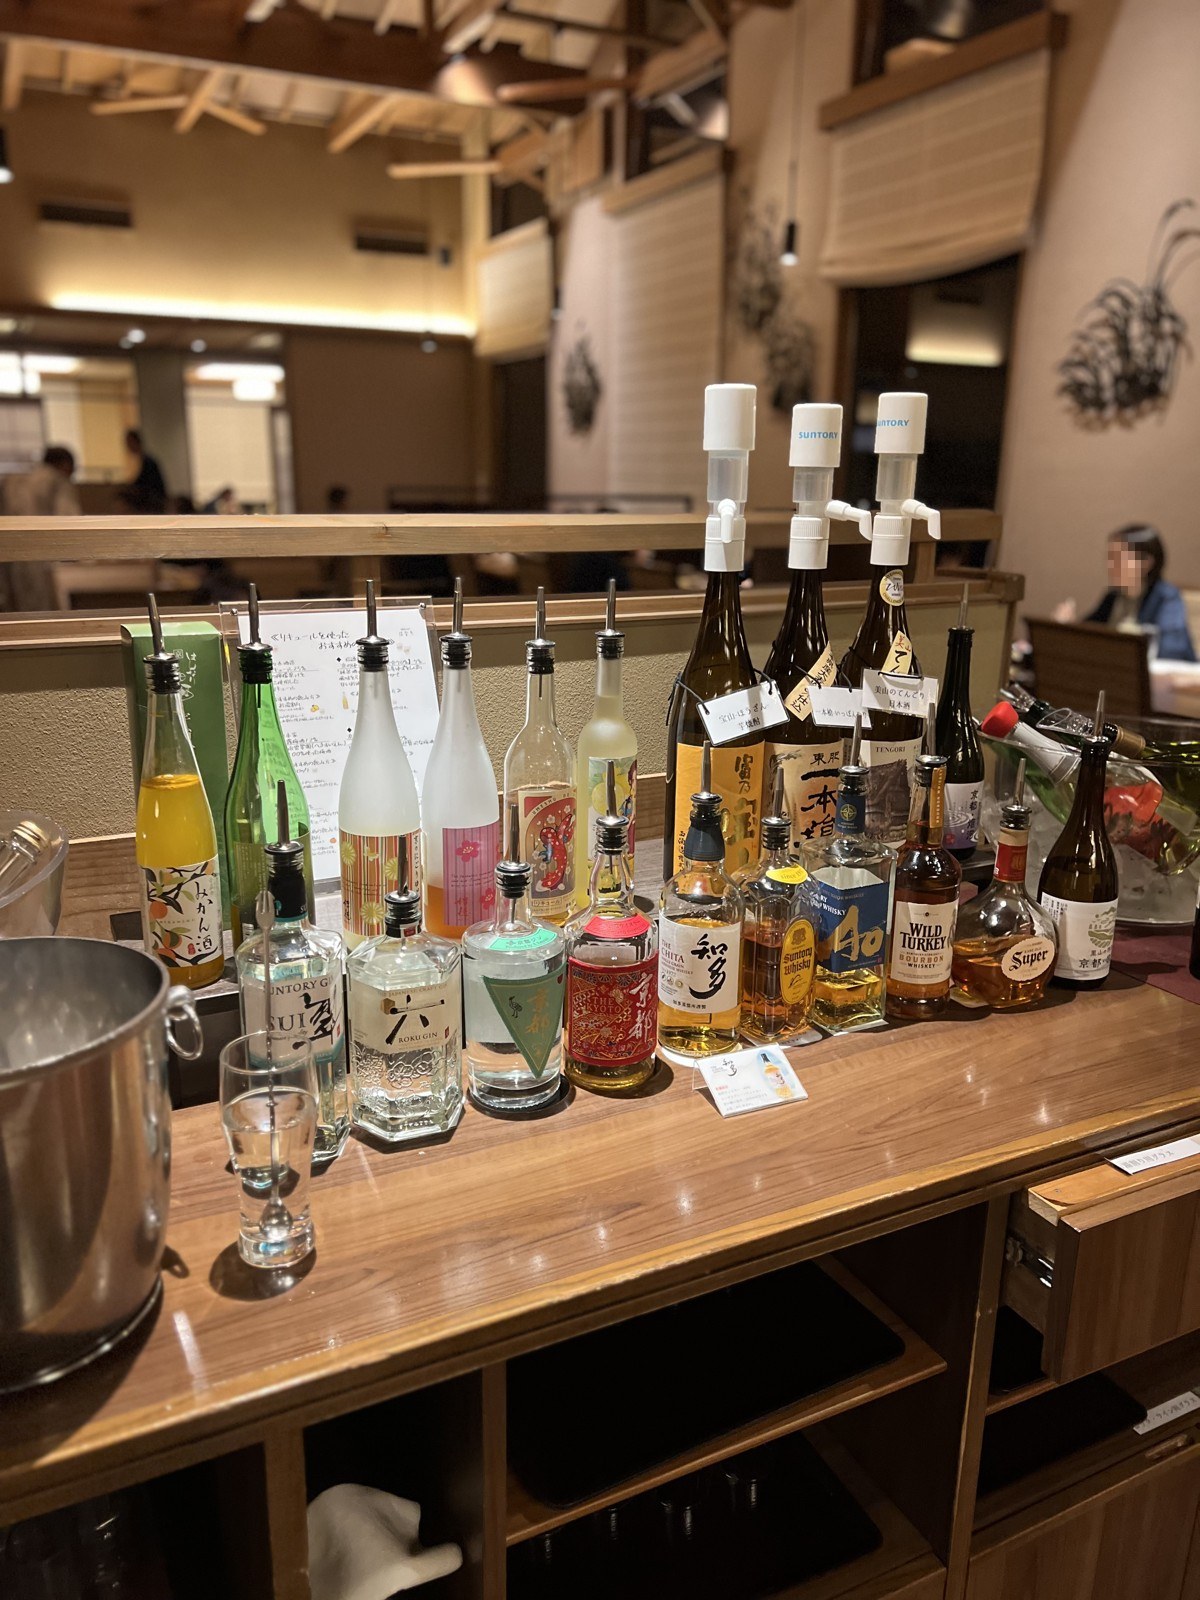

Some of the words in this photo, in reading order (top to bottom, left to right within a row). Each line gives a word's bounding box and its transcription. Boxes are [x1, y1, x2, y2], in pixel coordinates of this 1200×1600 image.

[877, 418, 910, 427] UNTORY
[798, 430, 839, 440] SUNTORY
[889, 700, 911, 710] 日本酒
[195, 881, 214, 952] みかん酒
[823, 902, 846, 916] WHISKY
[824, 904, 884, 962] Ao
[909, 922, 942, 937] WILD
[900, 931, 947, 952] TURKEY
[661, 947, 685, 964] CHITA
[783, 947, 812, 964] Suntory
[899, 954, 944, 963] BOURBON
[1009, 949, 1049, 972] Super
[689, 933, 728, 1000] 知多
[784, 959, 811, 976] Whisky
[264, 979, 317, 996] UNTORY
[587, 1005, 621, 1014] KYOTO
[593, 996, 615, 1006] THE
[627, 972, 653, 1042] 京都
[385, 994, 445, 1045] 六
[398, 1034, 421, 1044] ROKU
[423, 1031, 438, 1040] GIN
